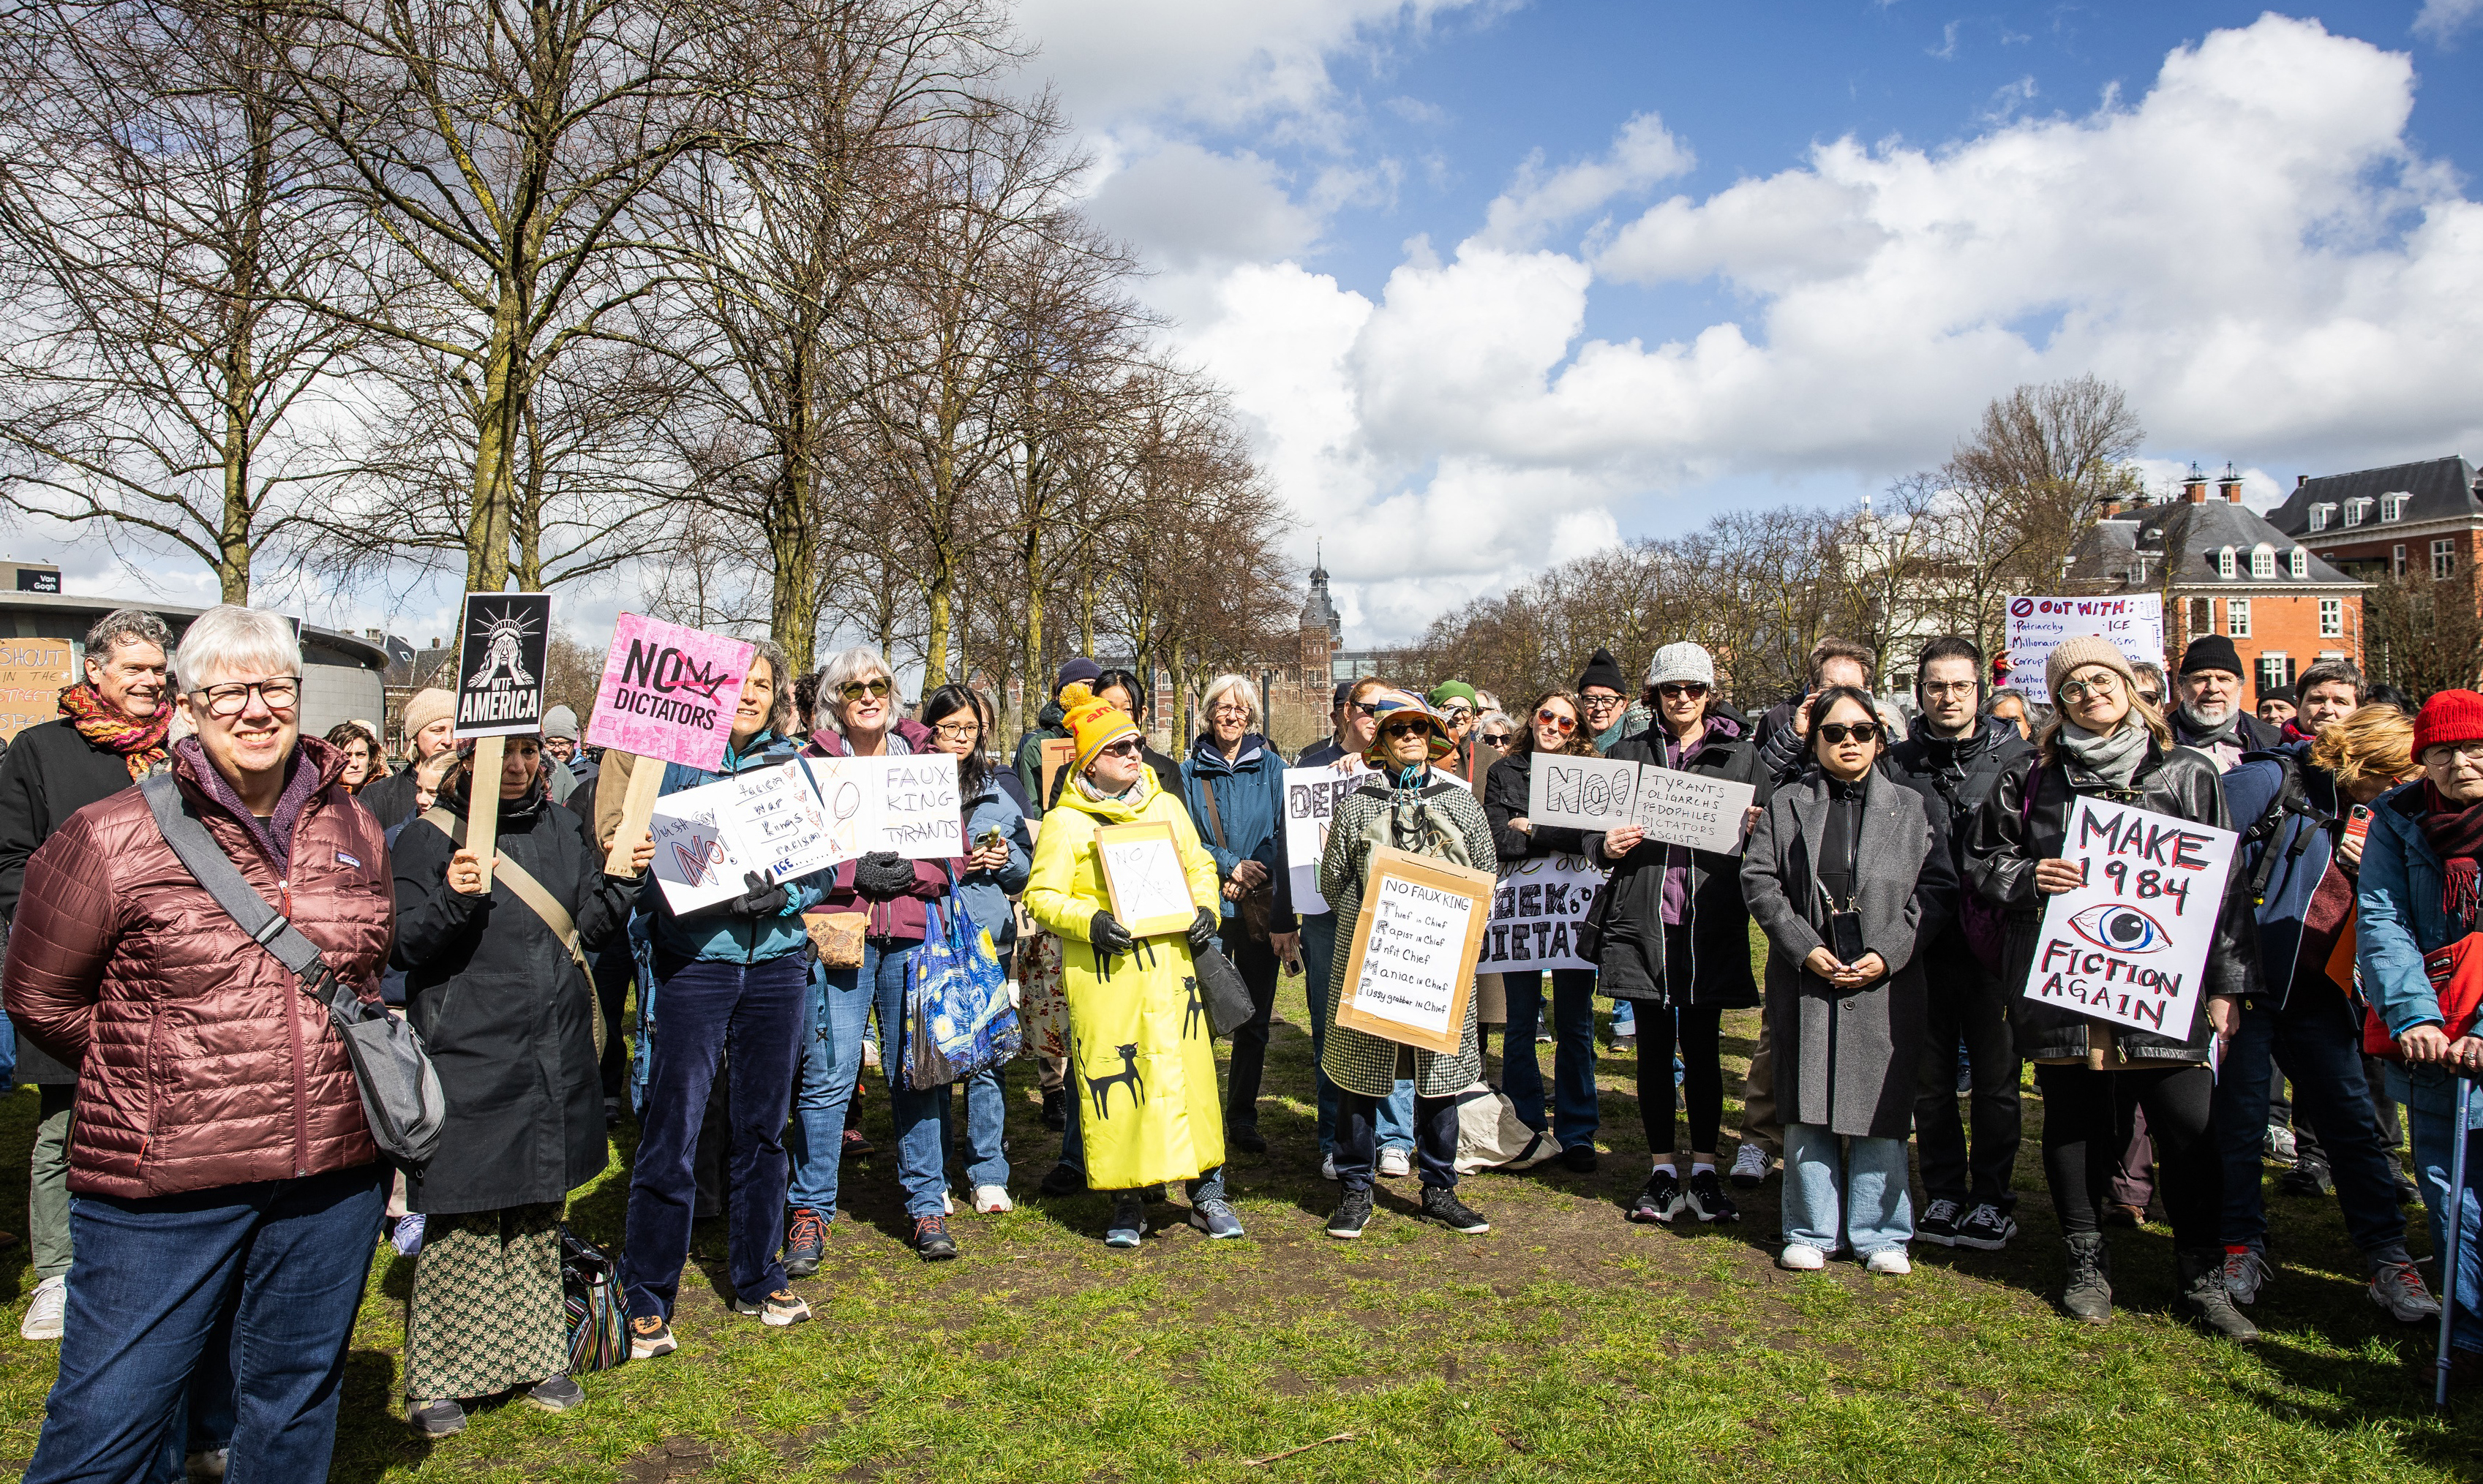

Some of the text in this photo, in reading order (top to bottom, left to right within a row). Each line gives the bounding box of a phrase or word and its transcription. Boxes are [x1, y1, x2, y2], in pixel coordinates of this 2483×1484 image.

[34, 582, 56, 591] Gogh
[2039, 600, 2134, 617] OUT WITH:
[2016, 620, 2063, 634] Patriarchy
[2108, 620, 2130, 631] ICE
[0, 648, 66, 666] SHOUT
[621, 639, 683, 693] NO
[3, 671, 58, 682] IN THE
[492, 677, 513, 691] WTF
[459, 690, 538, 723] AMERICA
[614, 688, 717, 730] DICTATORS
[0, 714, 59, 730] SPEA
[1653, 775, 1724, 798] TYRANTS
[887, 791, 954, 811] KING
[1648, 790, 1719, 810] OLIGARCHS
[1643, 802, 1716, 823] PEDOPHILES
[882, 820, 958, 844] TYRANTS
[1642, 815, 1715, 835] DICTATORS
[1643, 826, 1700, 845] FASCISTS
[2080, 805, 2215, 870] MAKE
[1108, 848, 1143, 865] NO
[1386, 880, 1469, 911] NO FAUX KING
[2078, 857, 2190, 916] 1984
[1381, 900, 1413, 920] Thief
[1424, 916, 1448, 929] Chief
[1370, 936, 1430, 965] Unfit Chief
[1424, 935, 1445, 946] Chief
[1362, 957, 1413, 984] Maniac
[1425, 978, 1449, 992] Chief
[2040, 938, 2182, 997] FICTION
[1424, 1001, 1447, 1014] Chief
[2042, 972, 2166, 1030] AGAIN
